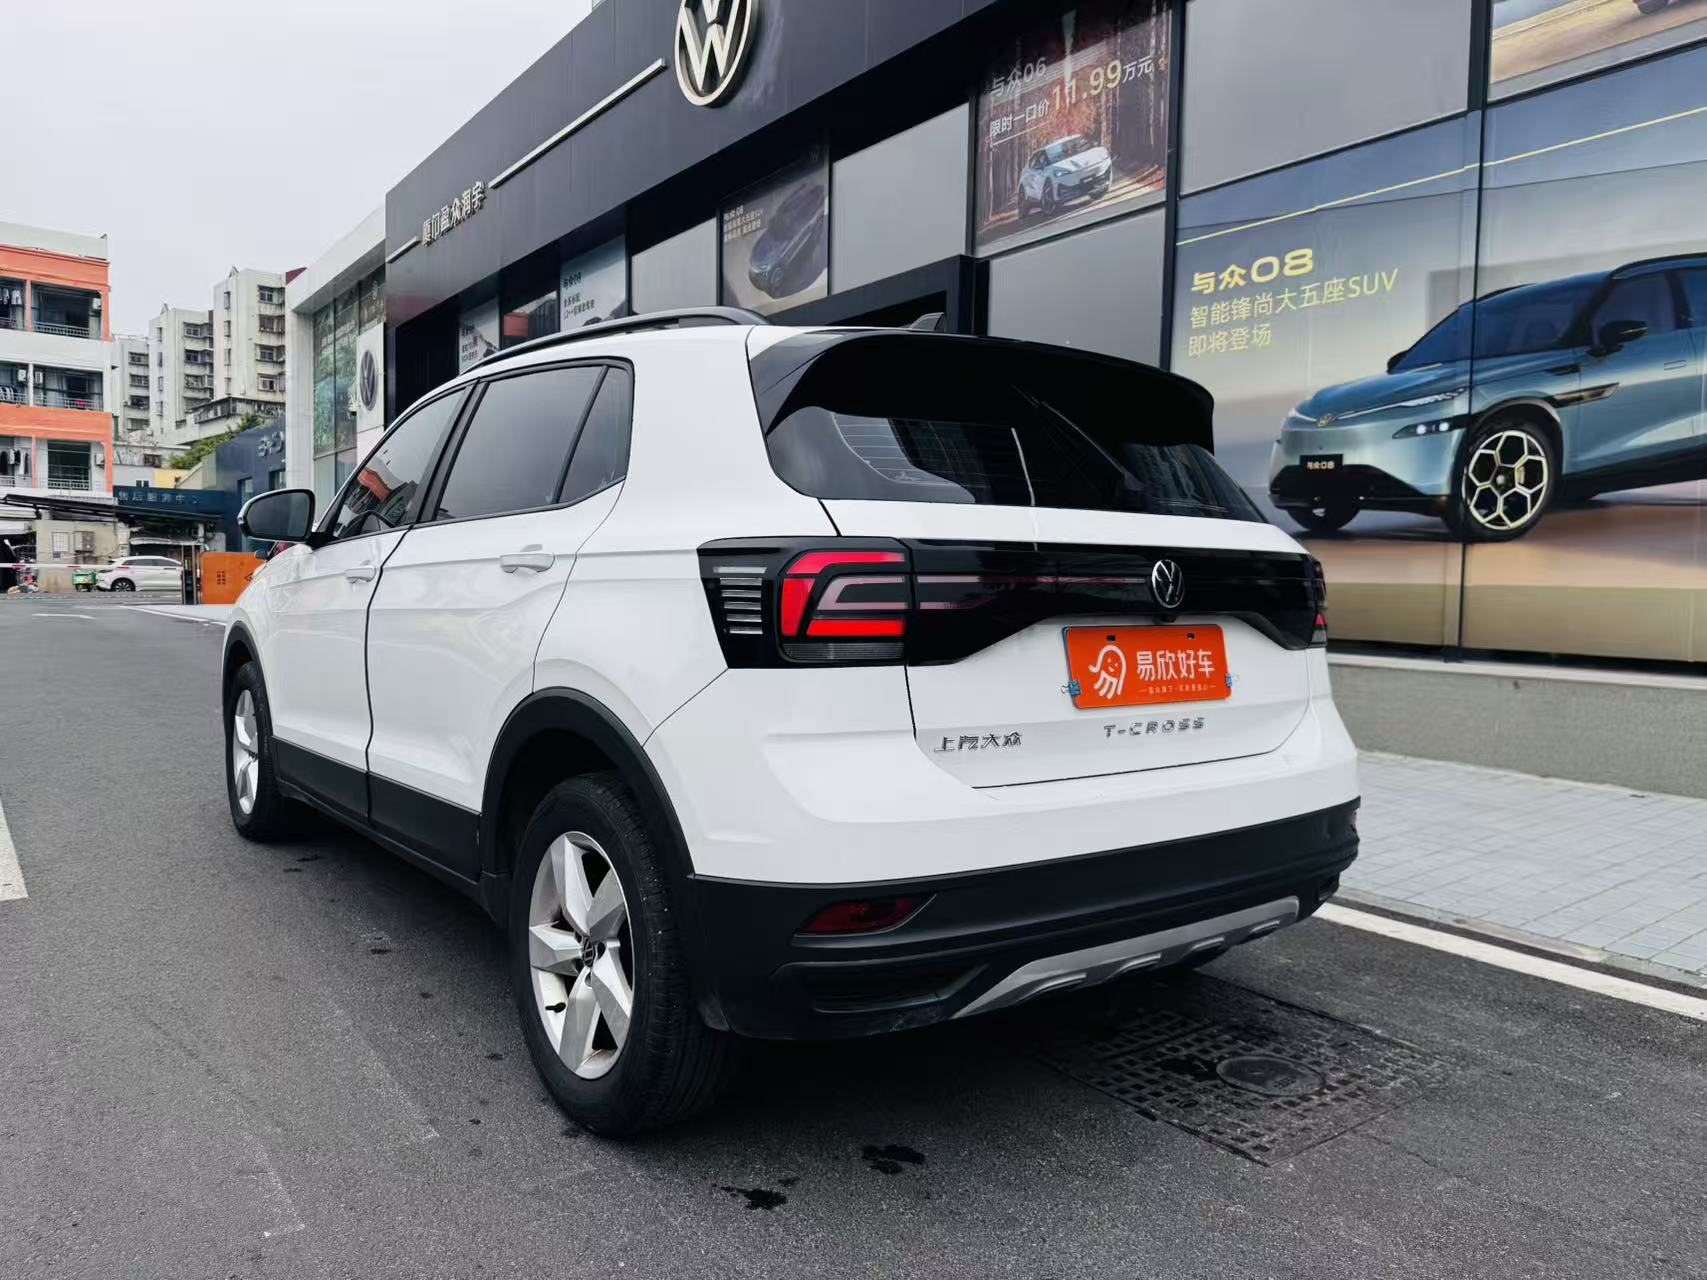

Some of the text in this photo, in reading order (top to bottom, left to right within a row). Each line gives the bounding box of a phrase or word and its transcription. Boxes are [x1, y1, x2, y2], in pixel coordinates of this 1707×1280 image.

[990, 57, 1047, 98] 与众06
[989, 98, 1051, 137] 限时一口价
[1191, 248, 1314, 295] 与众08
[1190, 268, 1399, 330] 智能锋尚大五座SUV
[1188, 323, 1272, 358] 即将登场
[1136, 649, 1216, 681] 易欣好车
[934, 730, 1022, 752] 上汽大众
[1103, 716, 1205, 738] T-CROSS
